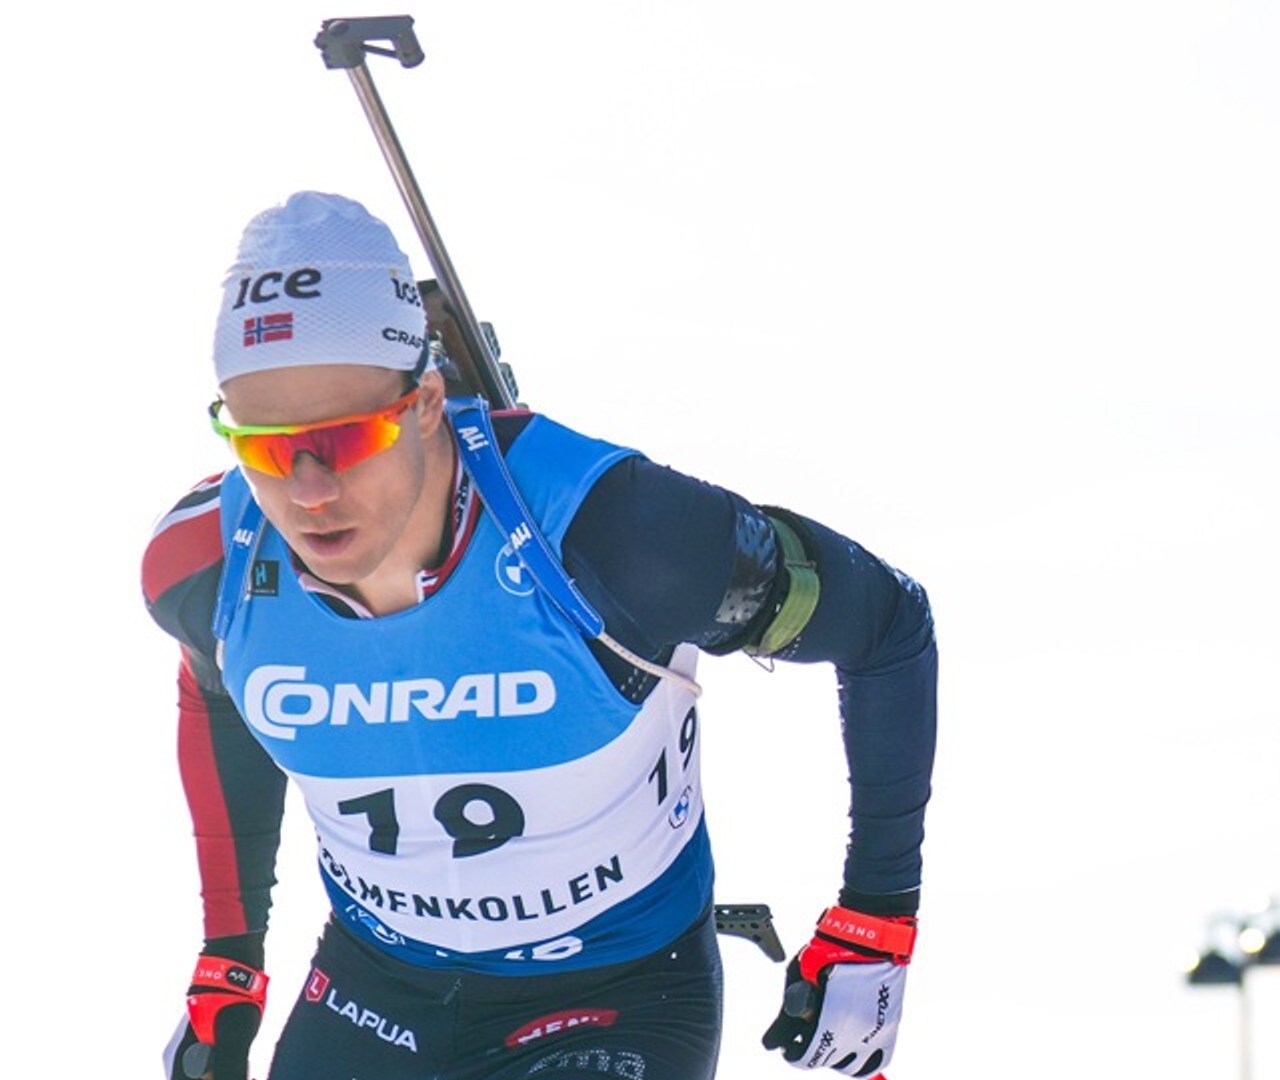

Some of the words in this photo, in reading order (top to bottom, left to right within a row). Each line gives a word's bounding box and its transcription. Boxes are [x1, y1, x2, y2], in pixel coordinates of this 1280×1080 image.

[244, 664, 557, 741] CONRAD
[338, 782, 525, 858] 19
[326, 988, 418, 1053] LAPUA
